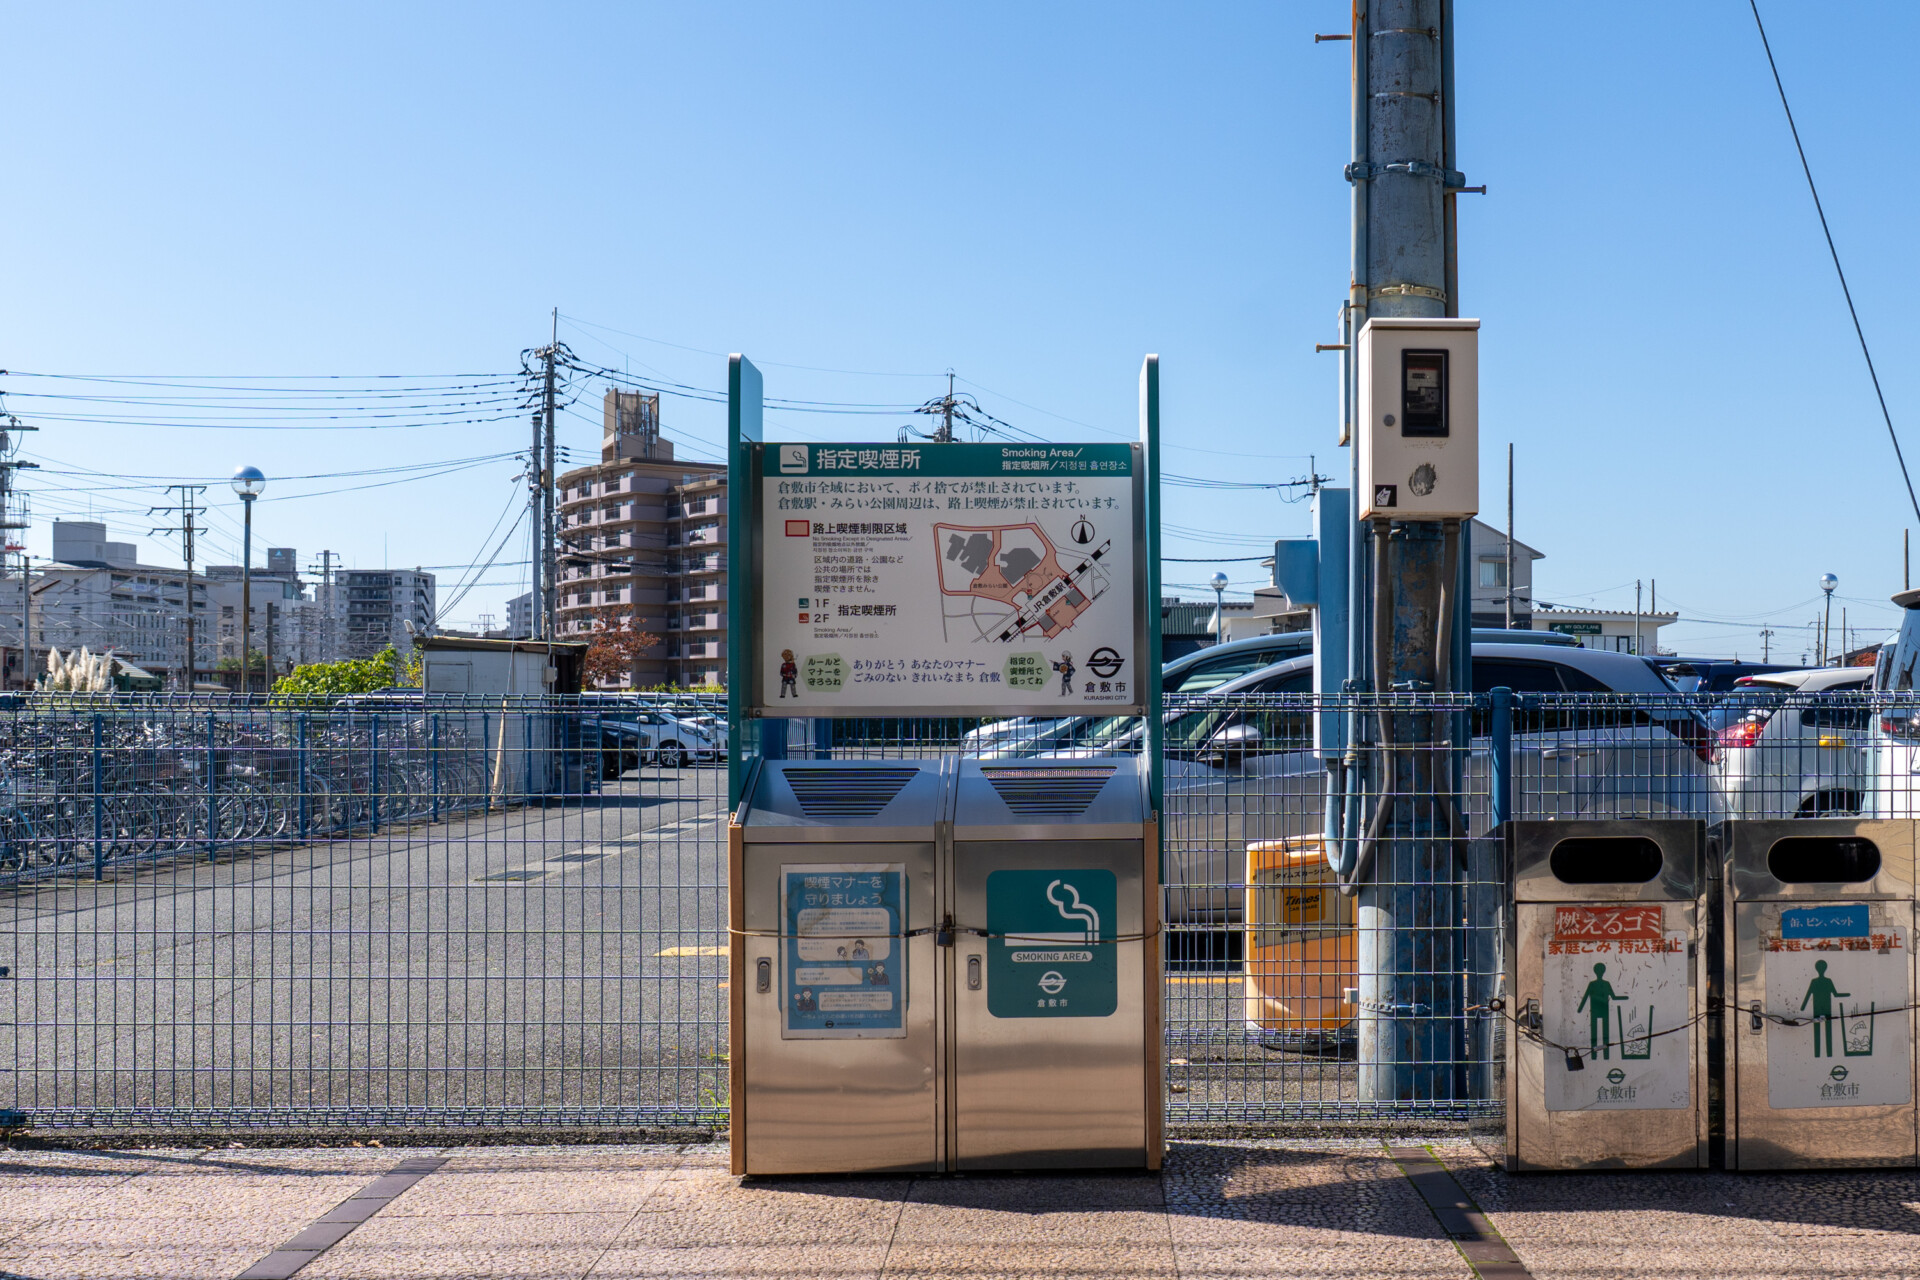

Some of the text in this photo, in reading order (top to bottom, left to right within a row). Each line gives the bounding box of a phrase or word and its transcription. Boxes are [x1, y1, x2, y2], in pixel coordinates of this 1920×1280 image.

[1002, 448, 1046, 458] Smoking
[817, 449, 921, 470] 指定喫煙所
[813, 523, 907, 534] 路上喫煙制限区域
[814, 556, 904, 564] 区域内の道路・公園など
[814, 566, 871, 574] 公共の場所では
[814, 575, 879, 584] 指定喫煙所を除き
[814, 585, 876, 594] 喫煙できません。
[1033, 582, 1066, 613] JR倉敷駅
[815, 598, 830, 608] 1F
[838, 604, 896, 616] 指定喫煙所
[814, 614, 830, 622] 2F
[808, 658, 840, 666] ルールと
[854, 660, 986, 670] ありがとう あなたのマナー
[808, 668, 840, 676] マナーを
[1010, 667, 1043, 675] 喫煙所で
[808, 678, 841, 686] 守ろうね
[854, 672, 1000, 682] ごみのない きれいなまち 倉敷
[1085, 682, 1126, 692] 倉敷市
[804, 876, 882, 889] 喫煙マナーを
[805, 893, 882, 906] 守りましょう
[1556, 911, 1661, 936] 燃えるゴミ
[1790, 917, 1854, 928] 缶、ビン、ペット
[1016, 952, 1088, 961] SMOKING AREA
[1037, 998, 1068, 1008] 倉敷市
[1596, 1086, 1637, 1100] 倉敷市
[1820, 1082, 1860, 1098] 倉敷市
